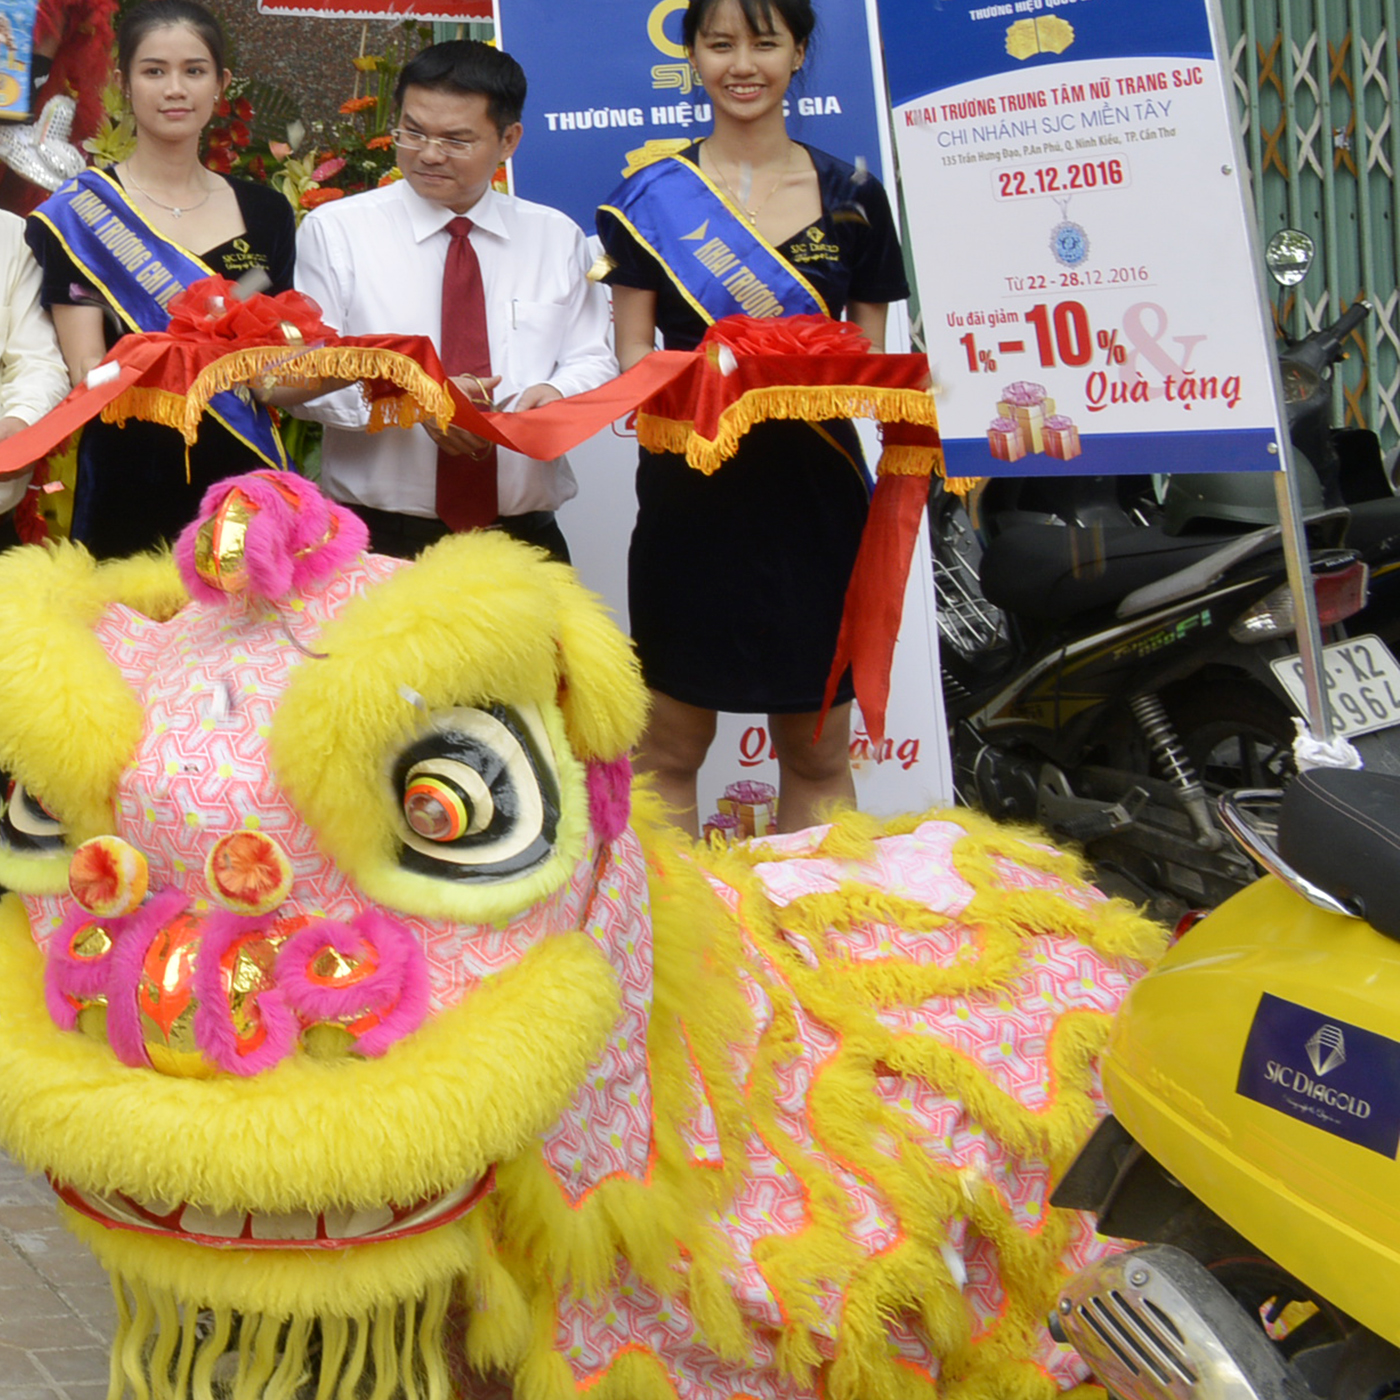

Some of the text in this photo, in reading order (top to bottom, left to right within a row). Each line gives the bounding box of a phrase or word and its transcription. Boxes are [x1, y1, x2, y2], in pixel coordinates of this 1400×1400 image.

[969, 4, 1014, 21] THƯƠNG
[545, 101, 712, 131] THƯƠNG HIỆU
[797, 95, 842, 117] GIA
[904, 66, 1204, 127] KHAI TRƯƠNG TRUNG TÂM NỮ TRANG SJC
[937, 99, 1173, 148] CHI NHÁNH SJC MIỀN TÂY
[941, 154, 957, 167] 135
[978, 149, 1001, 165] Hưng
[1075, 134, 1098, 150] Ninh
[998, 158, 1124, 198] 22.12.2016
[68, 188, 112, 229] KHAI
[135, 261, 175, 295] CHI
[693, 236, 736, 277] KHAI
[1004, 275, 1025, 293] Từ
[1027, 275, 1047, 290] 22
[946, 308, 1020, 328] Ưu đãi giảm
[1085, 368, 1242, 412] Quà tặng
[1263, 1059, 1294, 1088] SJC
[1292, 1071, 1371, 1119] DIAGOLD
